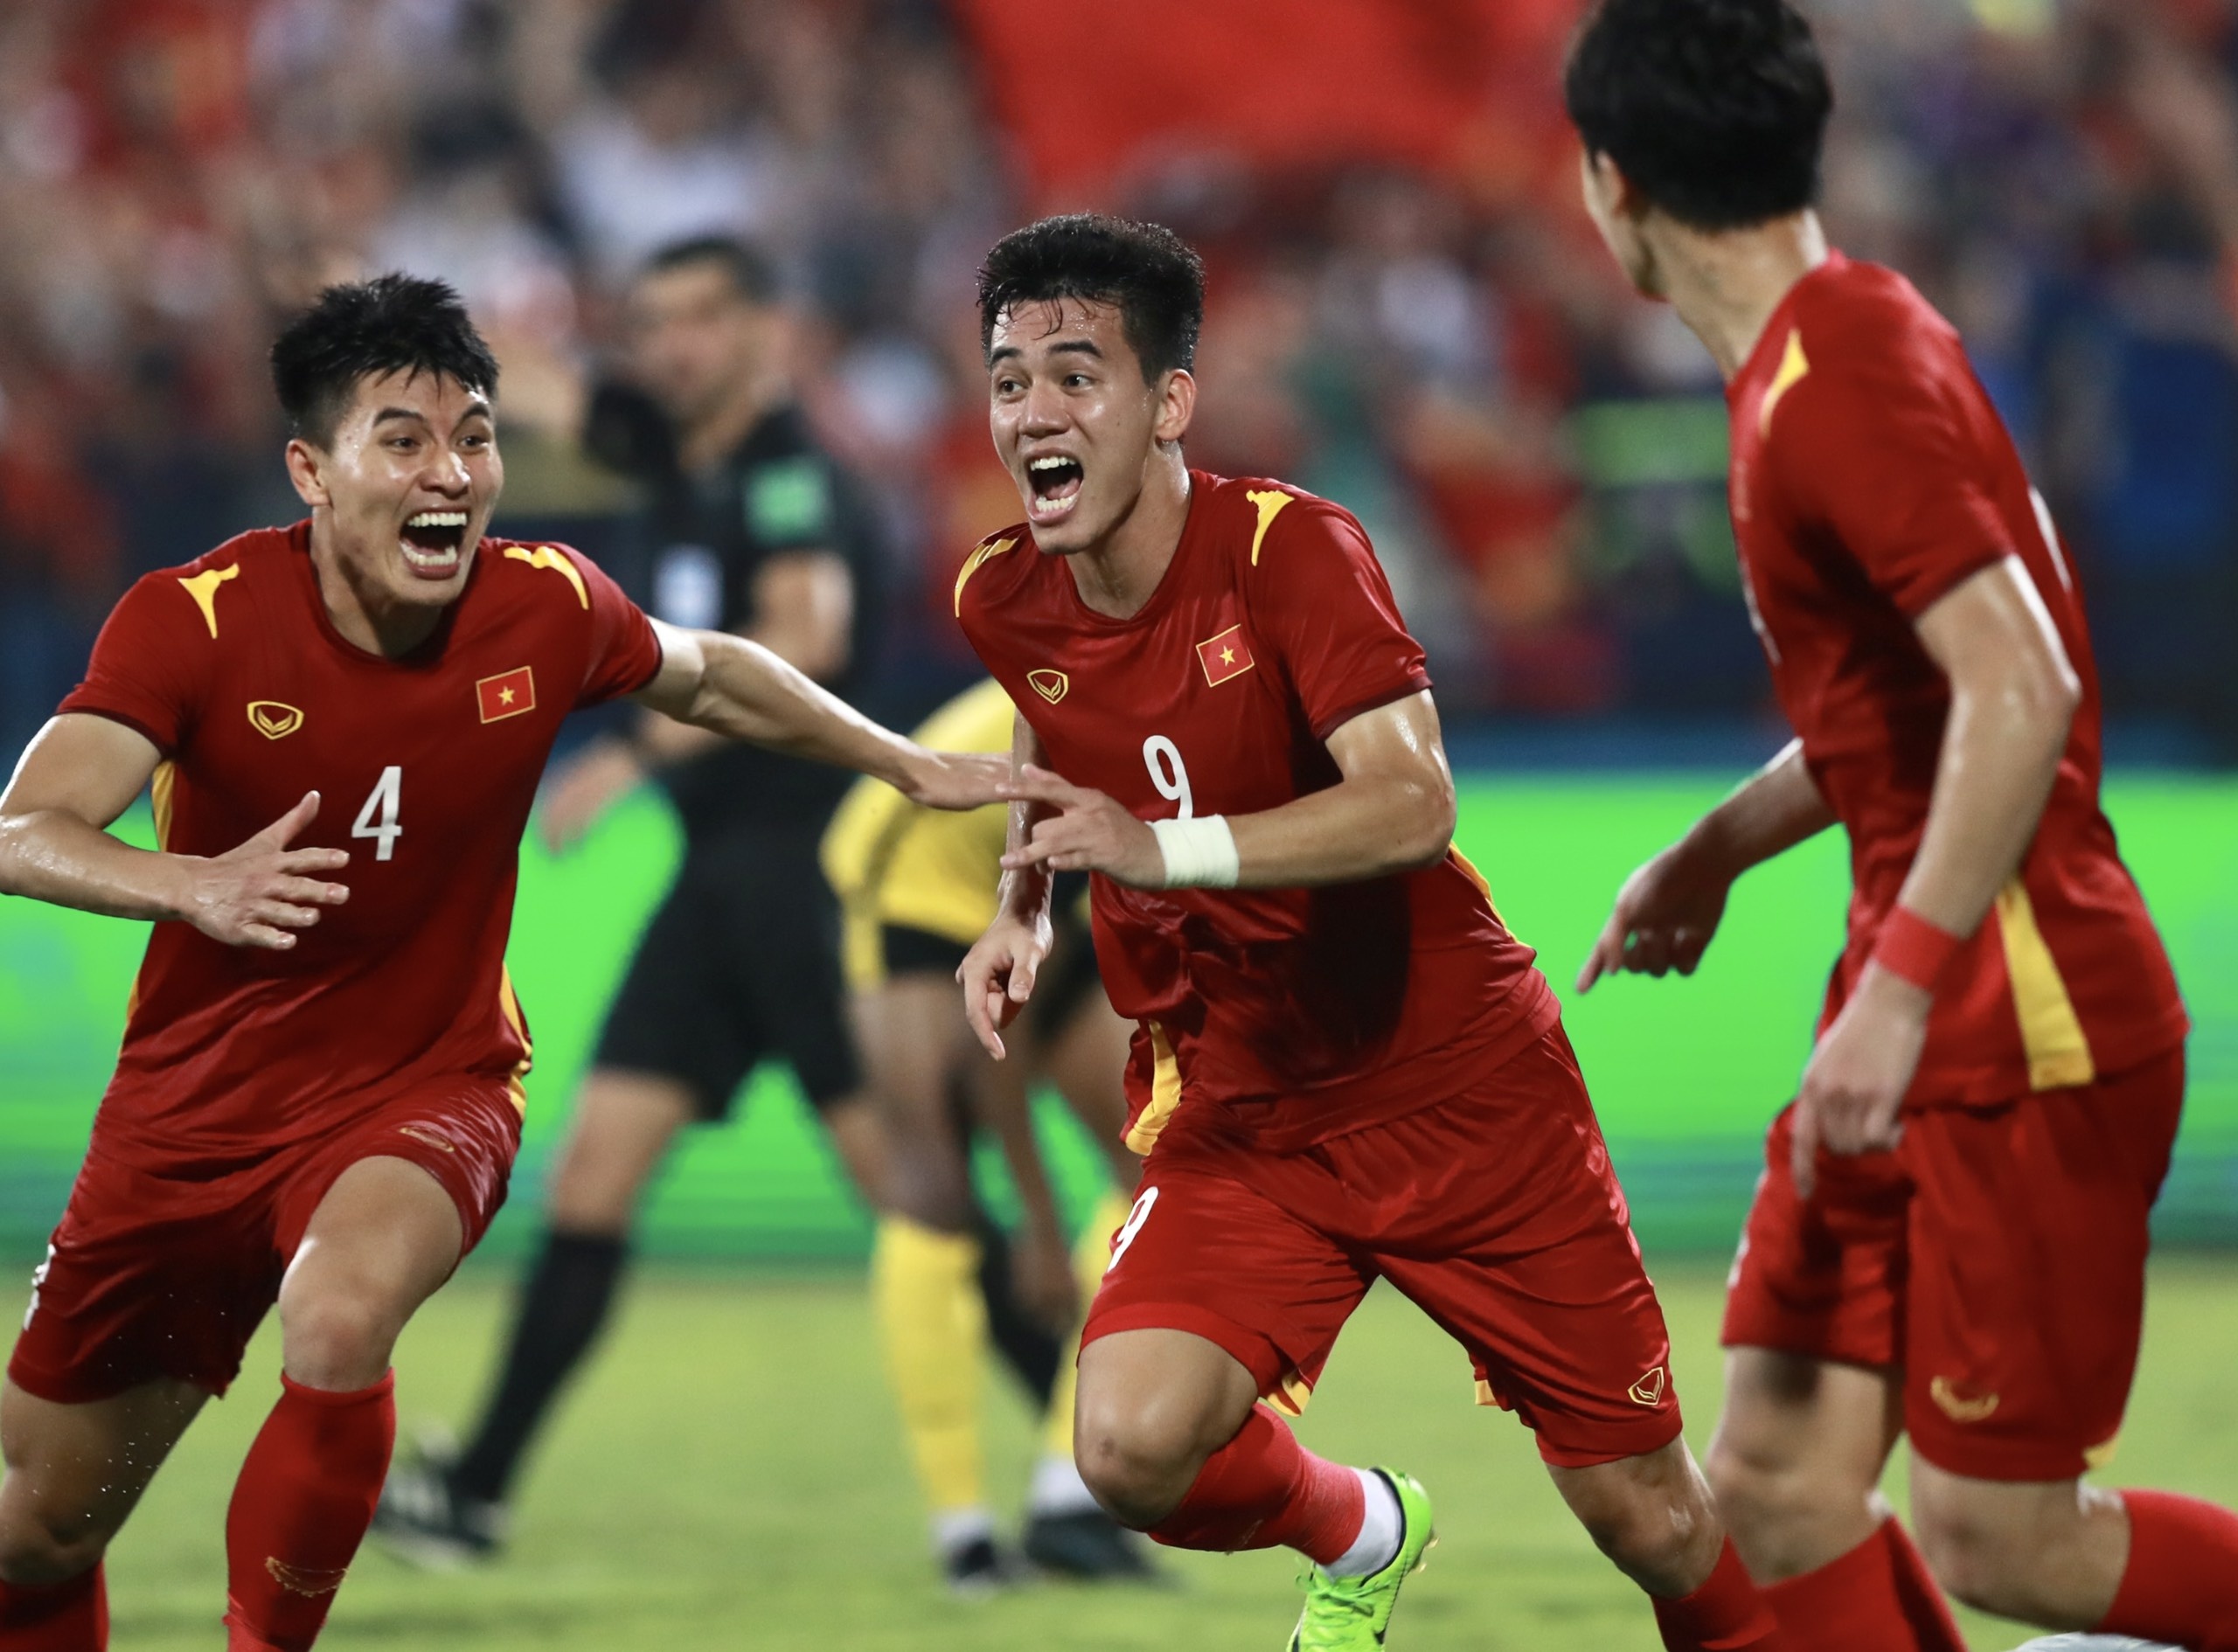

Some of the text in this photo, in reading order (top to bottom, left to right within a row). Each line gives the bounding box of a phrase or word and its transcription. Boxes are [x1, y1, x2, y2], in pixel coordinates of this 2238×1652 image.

[351, 765, 403, 861] 4
[1143, 734, 1193, 819] 9
[1106, 1185, 1159, 1274] 9
